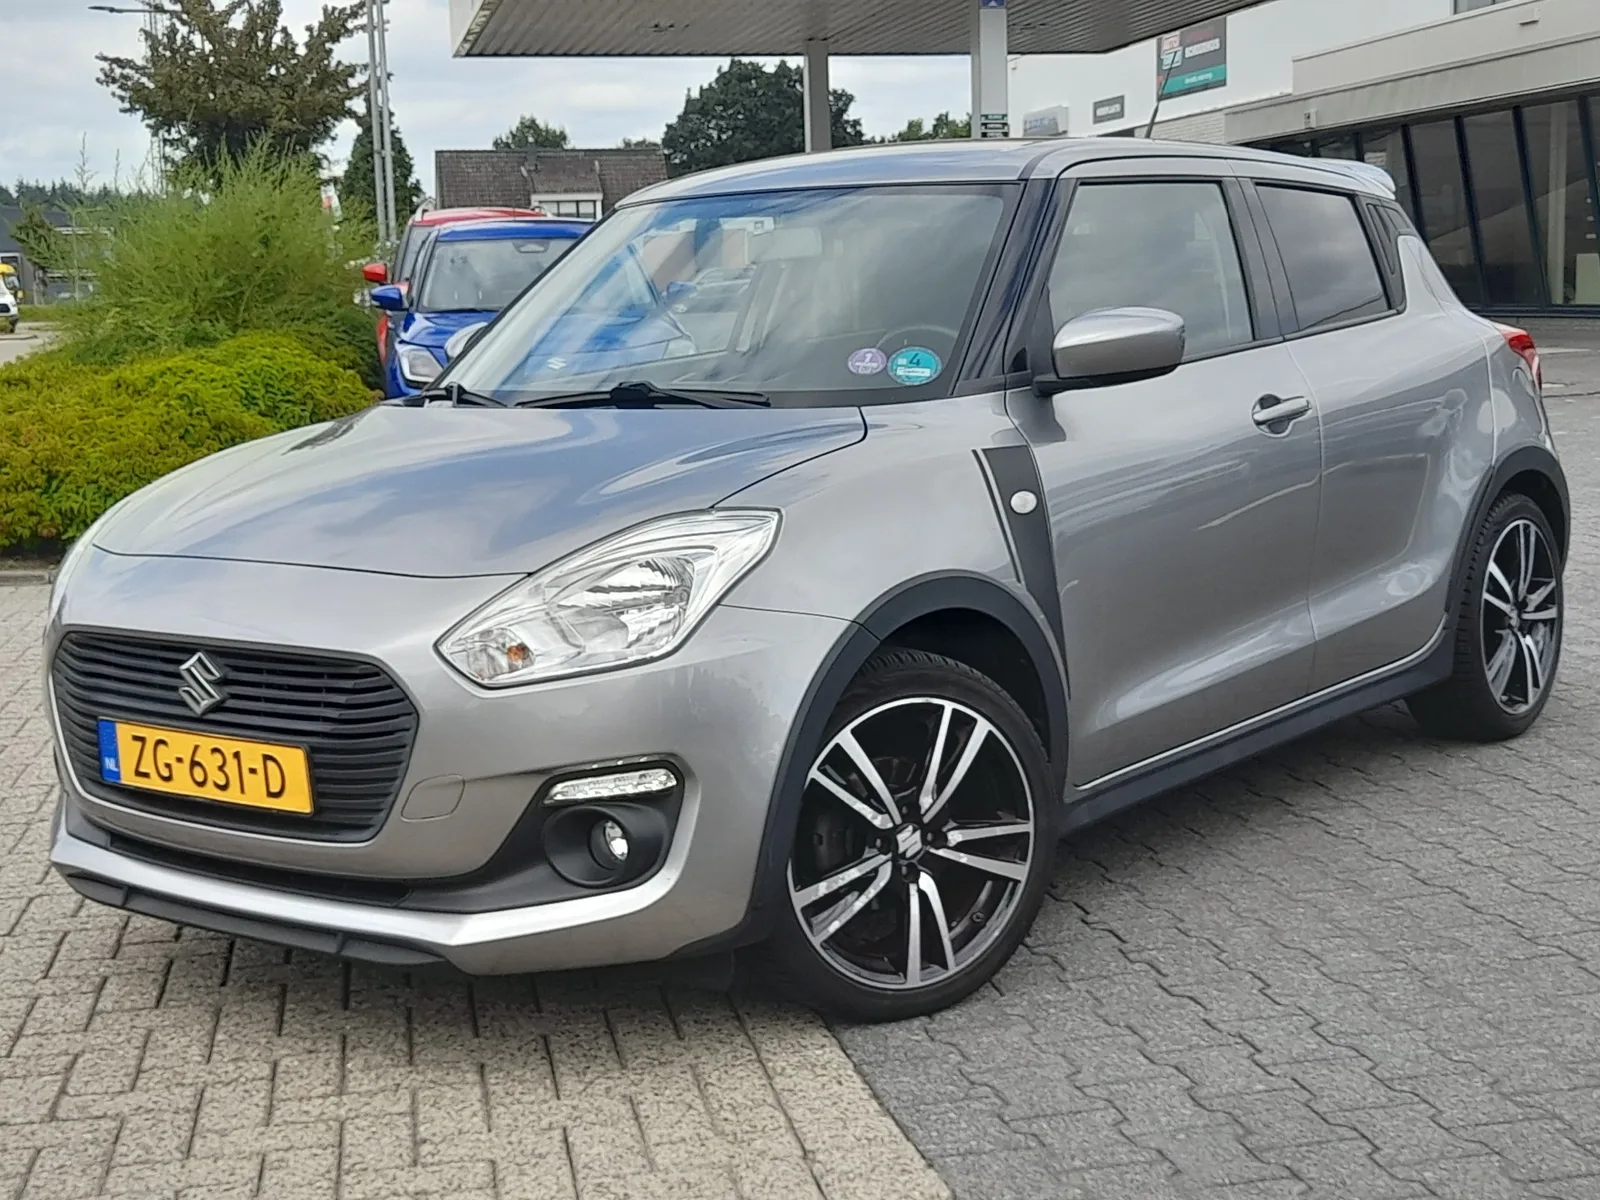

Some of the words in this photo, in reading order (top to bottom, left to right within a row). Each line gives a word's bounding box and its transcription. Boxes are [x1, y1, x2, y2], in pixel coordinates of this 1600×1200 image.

[908, 352, 921, 365] 4
[105, 757, 120, 772] NL
[131, 735, 286, 798] ZG-631-D
